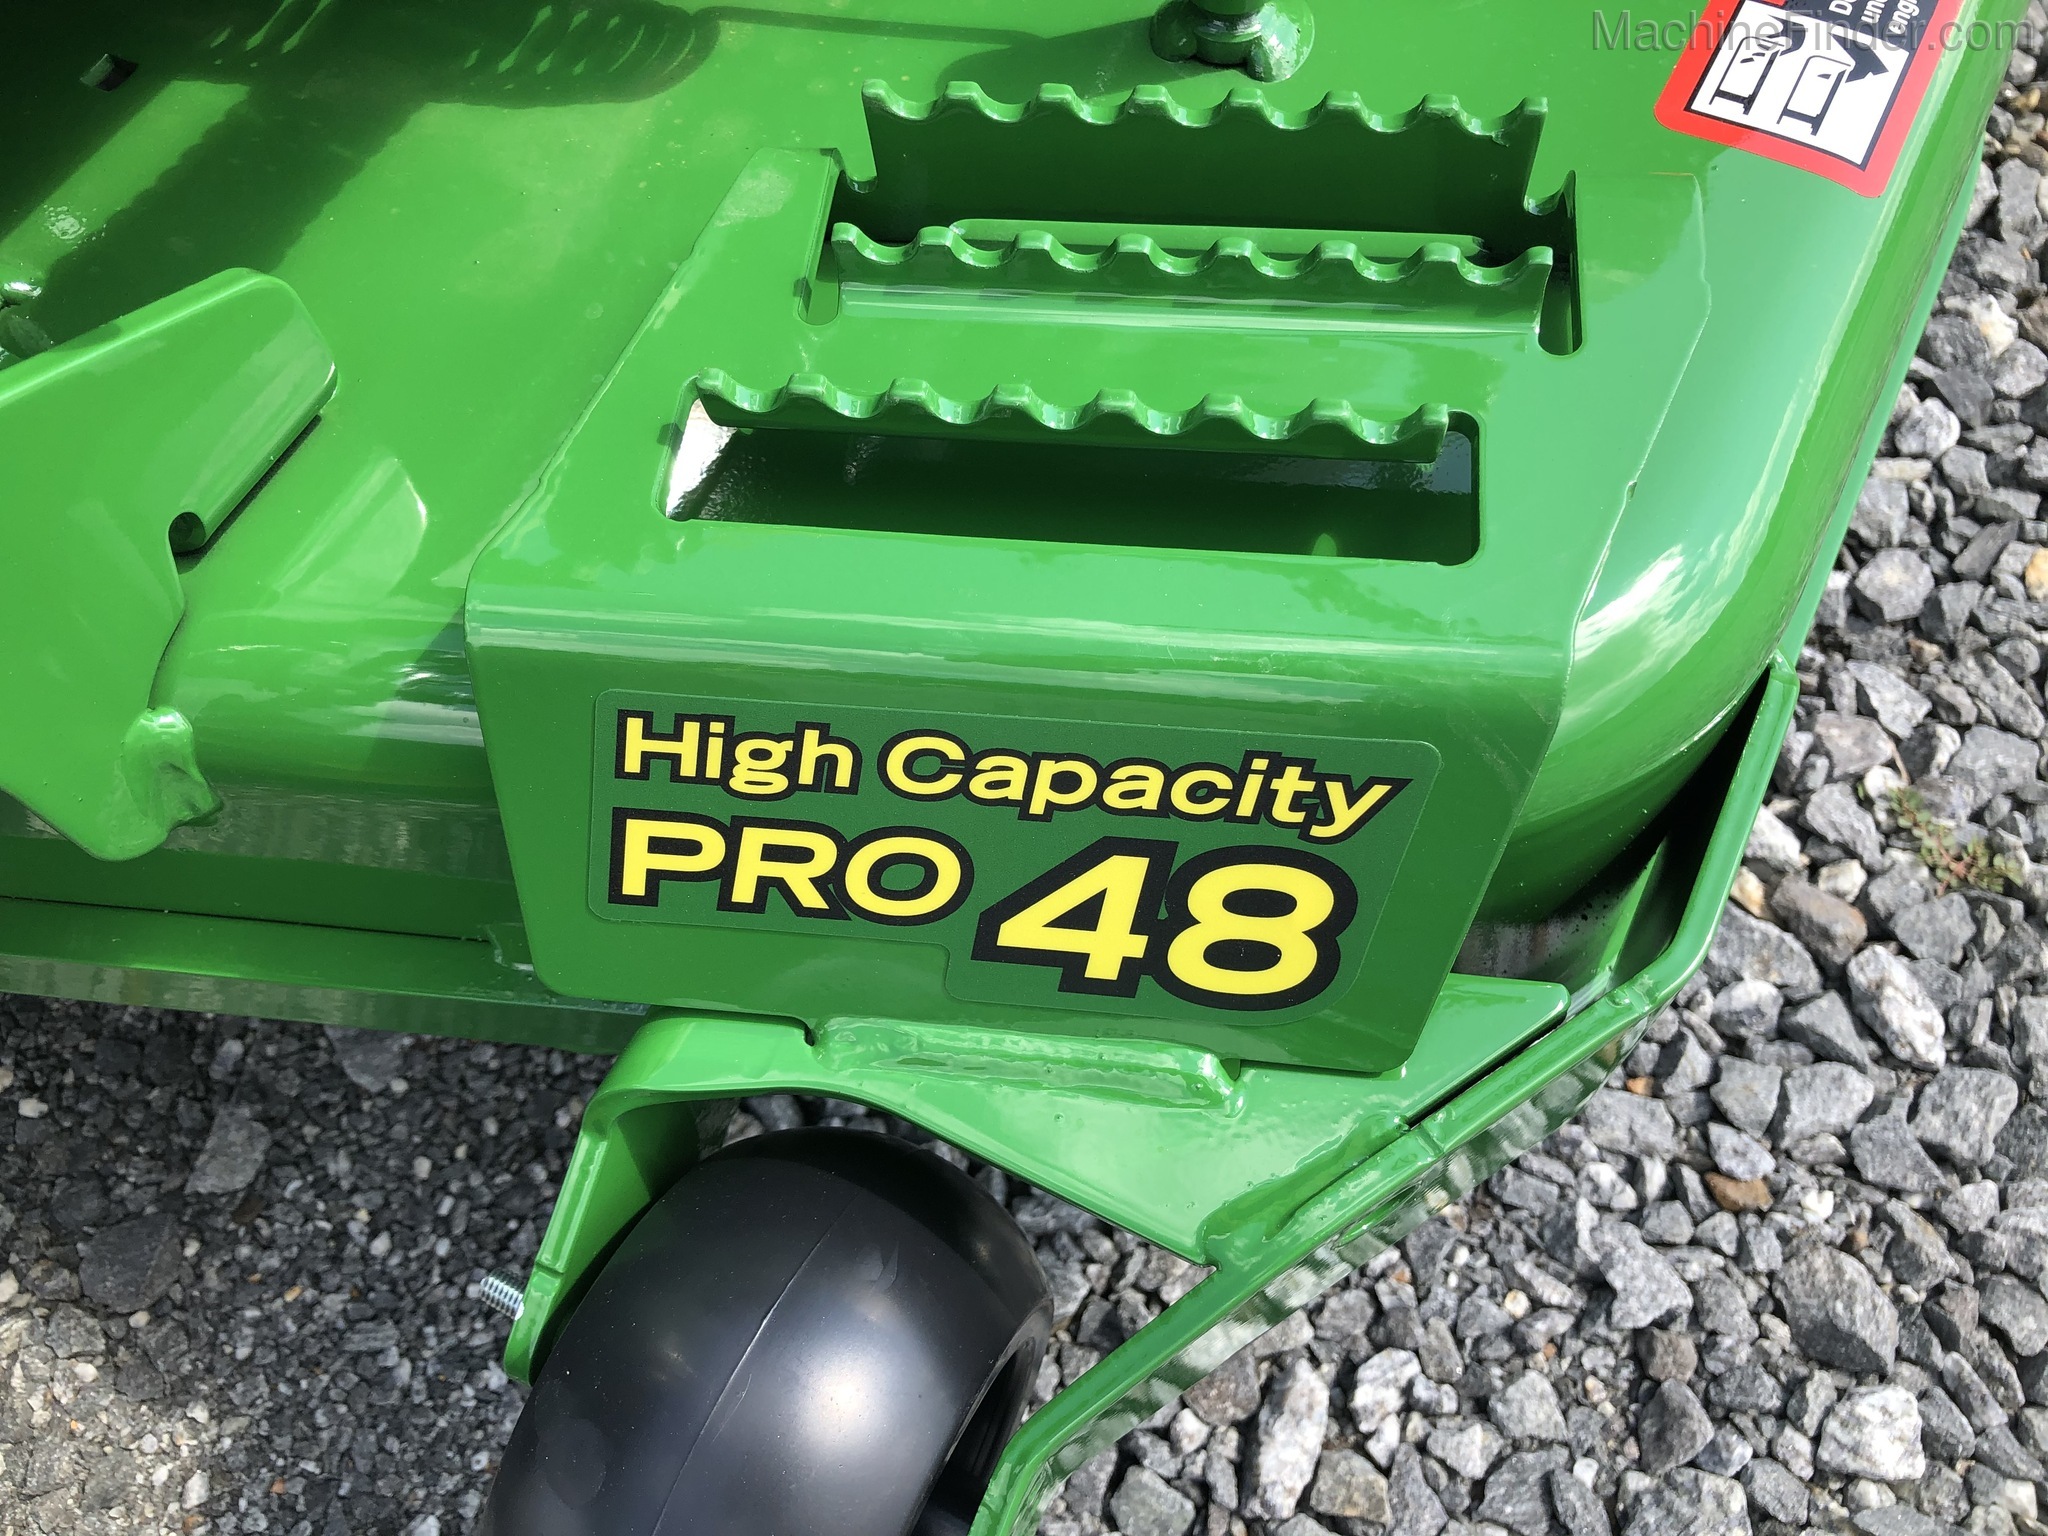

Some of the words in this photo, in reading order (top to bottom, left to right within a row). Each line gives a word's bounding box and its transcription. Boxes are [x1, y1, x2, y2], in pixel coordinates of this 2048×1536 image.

[620, 714, 855, 797] High
[883, 731, 1395, 840] Capacity
[618, 816, 967, 916] PRO
[990, 850, 1340, 998] 48
